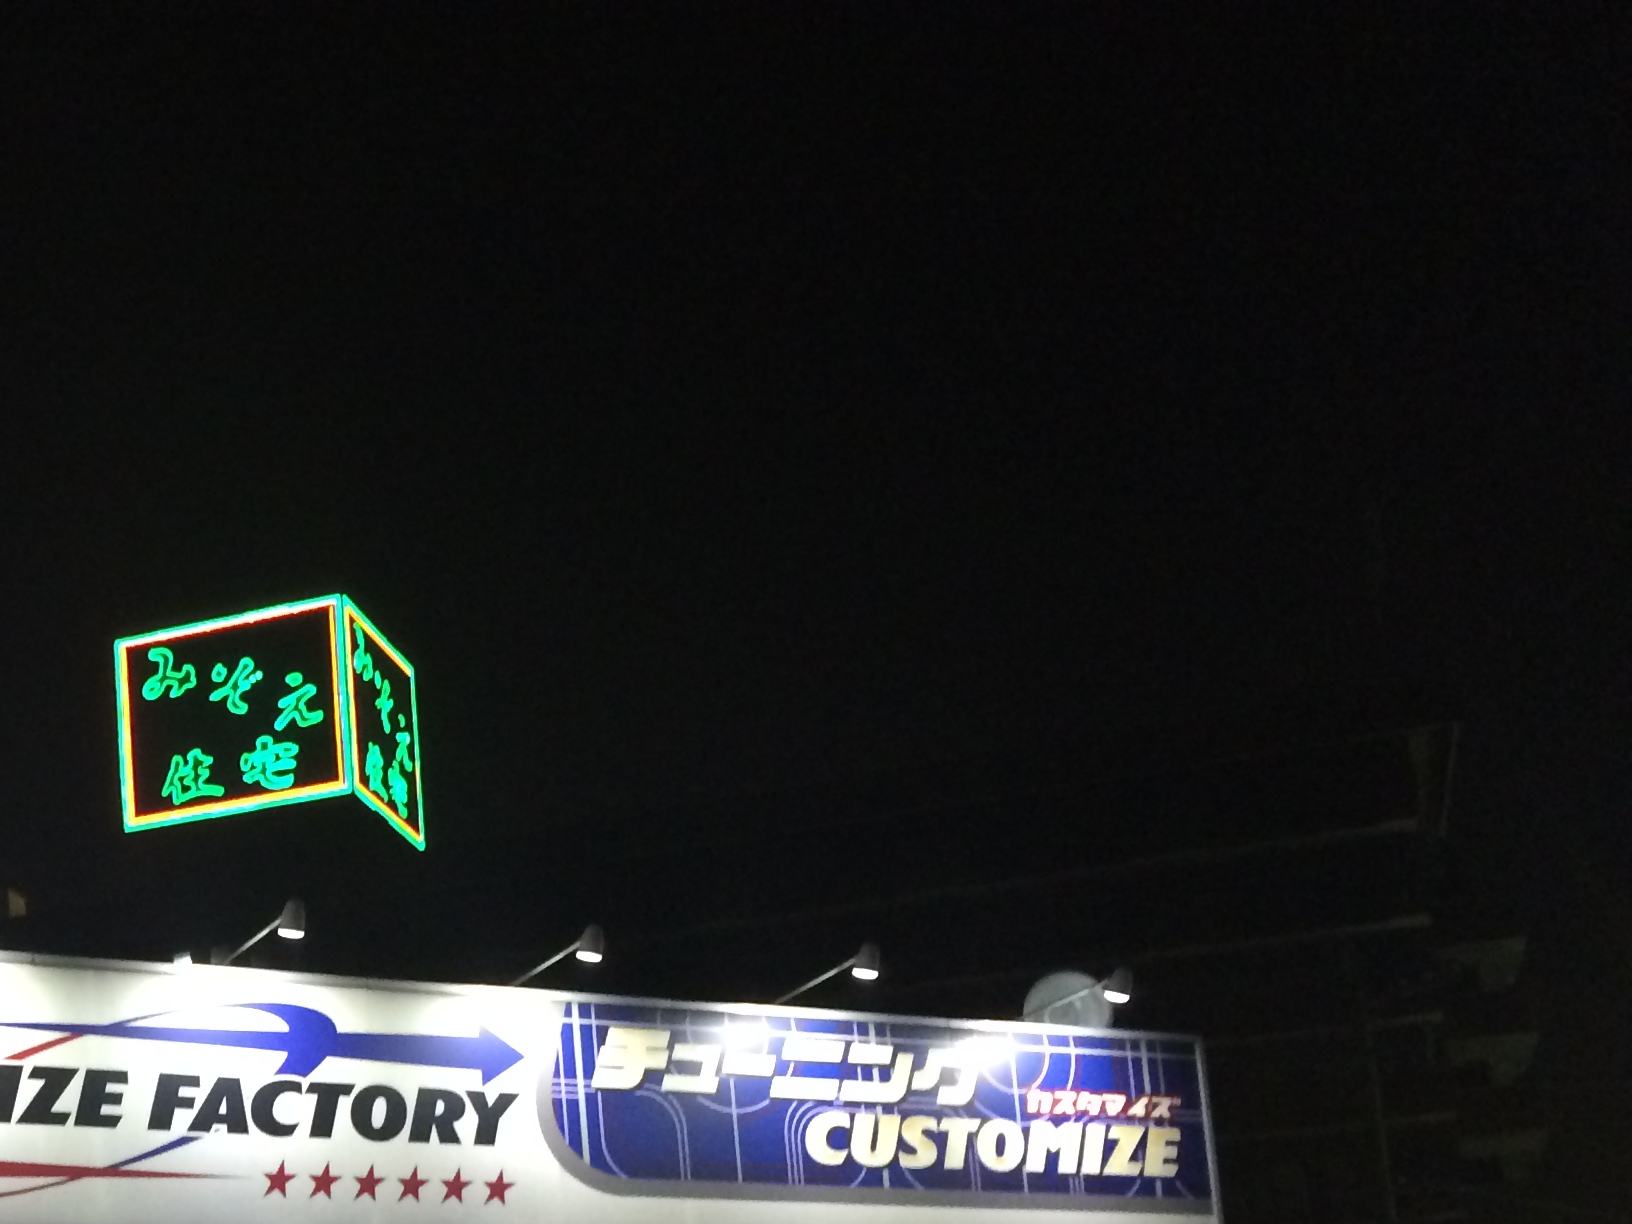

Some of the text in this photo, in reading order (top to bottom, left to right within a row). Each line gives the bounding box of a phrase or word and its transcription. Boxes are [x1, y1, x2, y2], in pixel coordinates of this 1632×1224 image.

[148, 1072, 520, 1147] FACTORY
[1027, 1088, 1181, 1119] カスタマイズ
[805, 1109, 1182, 1179] CUSTOMIZE
